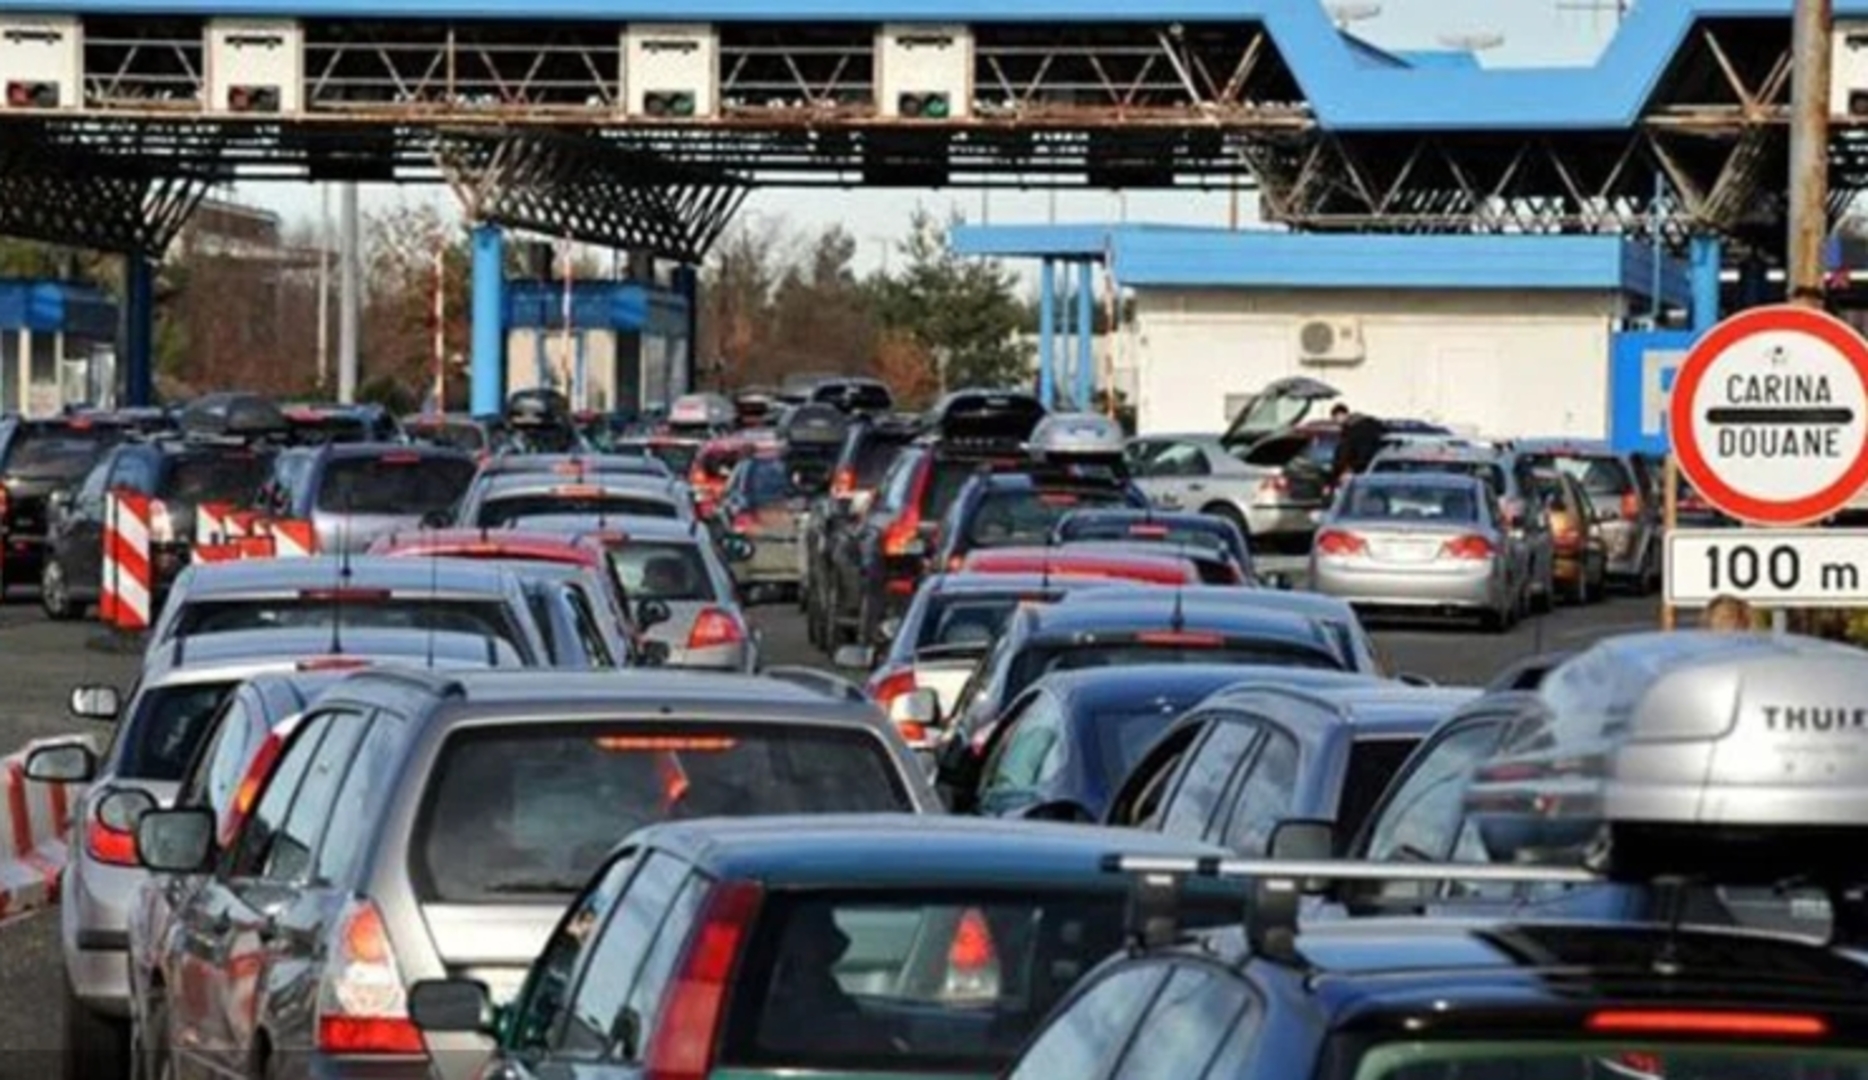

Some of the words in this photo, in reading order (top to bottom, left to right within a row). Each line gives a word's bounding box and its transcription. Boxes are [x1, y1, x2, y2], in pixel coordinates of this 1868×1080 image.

[1726, 374, 1832, 403] CARINA
[1718, 428, 1840, 458] DOUANE
[1705, 546, 1800, 589] 100
[1821, 562, 1858, 589] m
